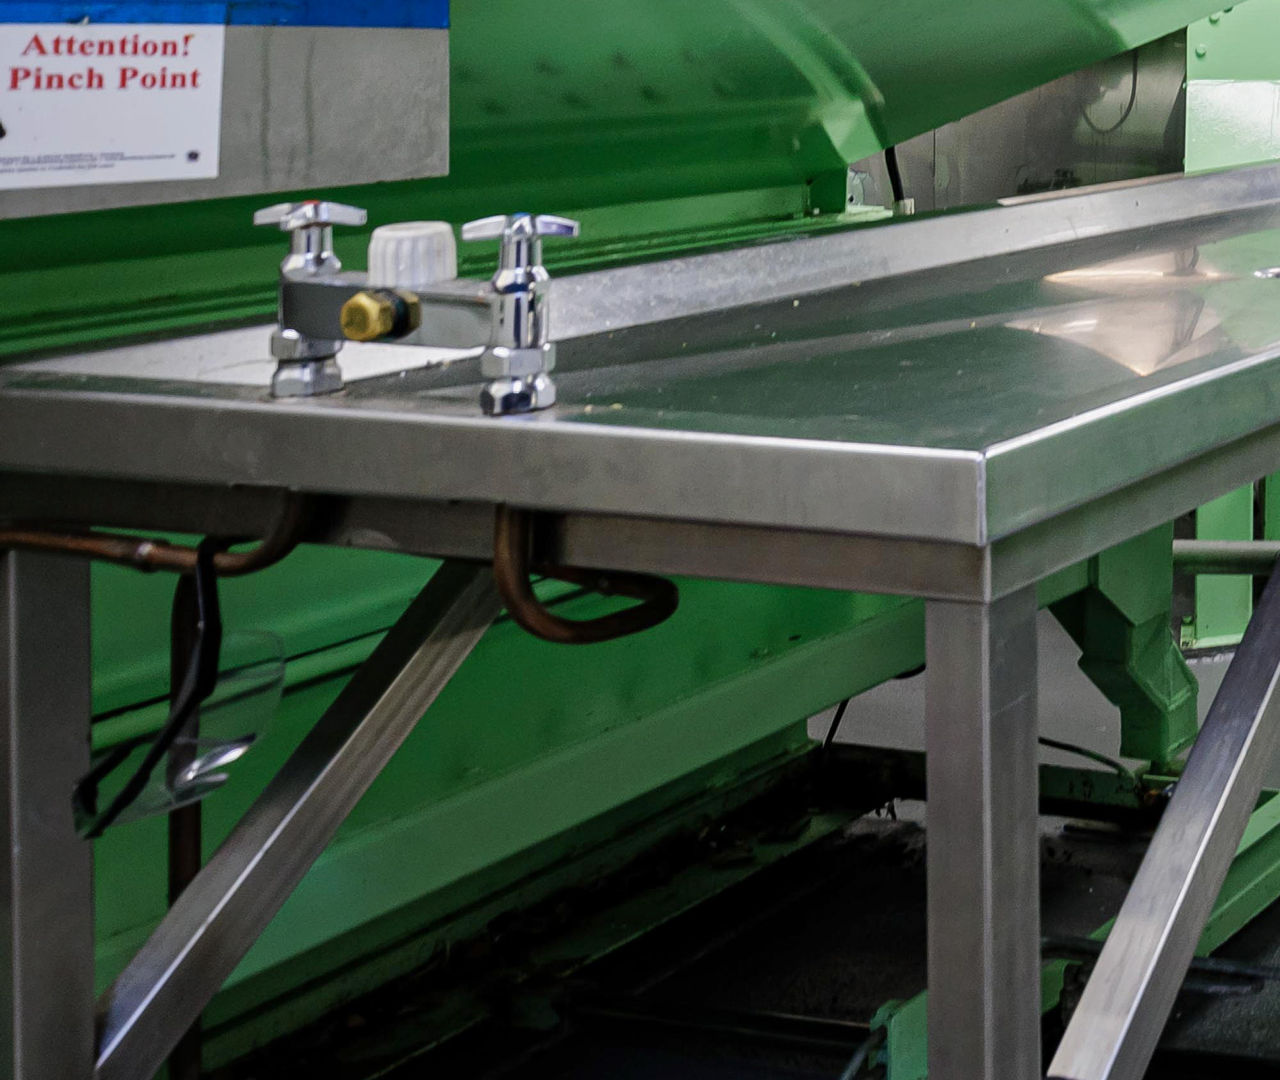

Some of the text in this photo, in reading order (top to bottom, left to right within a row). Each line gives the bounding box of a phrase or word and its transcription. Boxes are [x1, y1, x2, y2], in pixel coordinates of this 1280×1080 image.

[22, 33, 192, 57] Attention!
[9, 66, 201, 91] Pinch Point
